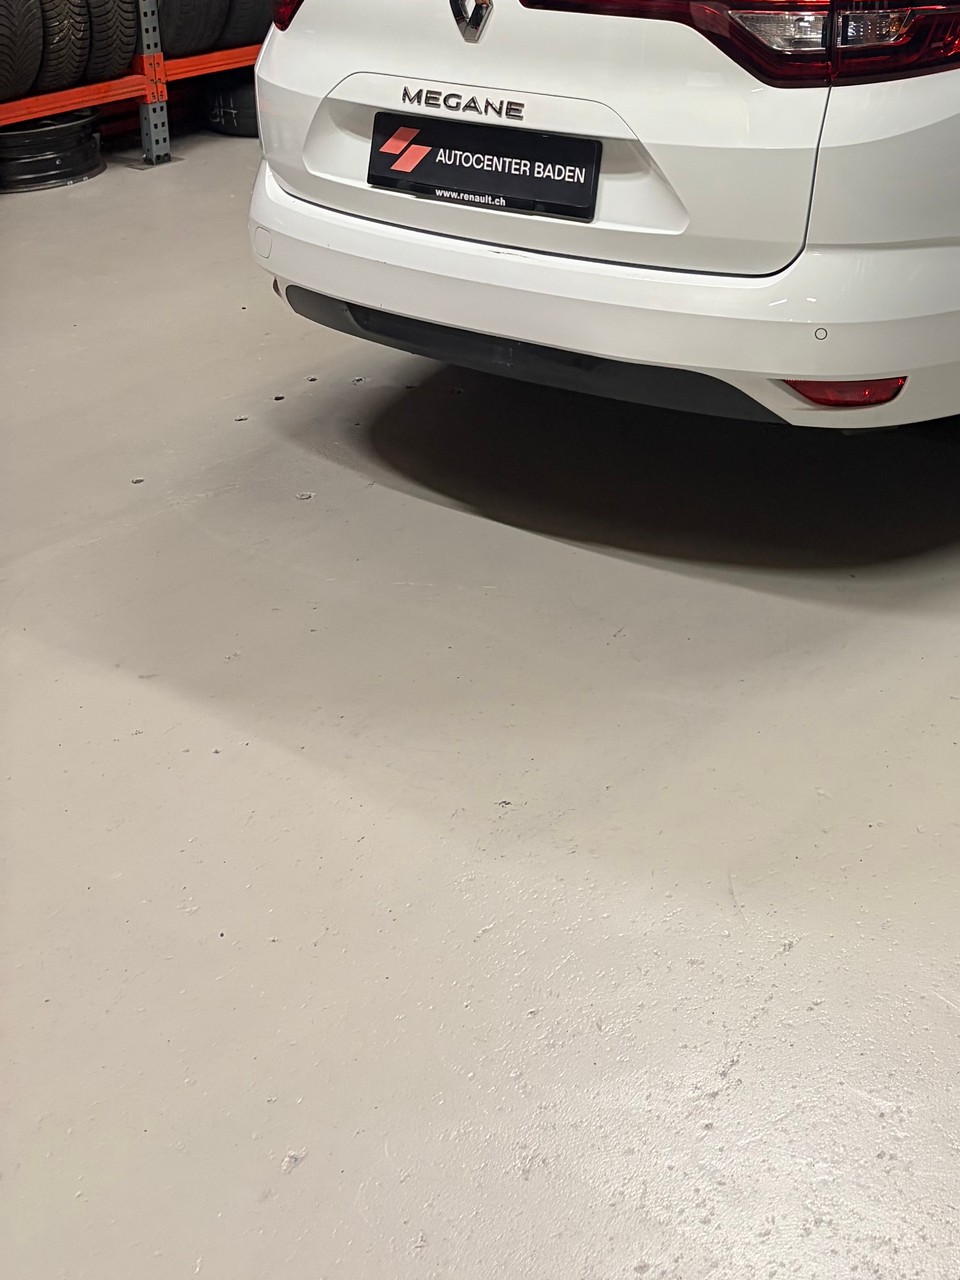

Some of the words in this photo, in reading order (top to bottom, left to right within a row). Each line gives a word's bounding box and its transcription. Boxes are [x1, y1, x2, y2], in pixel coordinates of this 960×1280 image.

[402, 86, 525, 120] MEGANE
[435, 147, 531, 176] AUTOCENTER
[533, 161, 586, 184] BADEN
[435, 188, 505, 206] www.renault.ch
